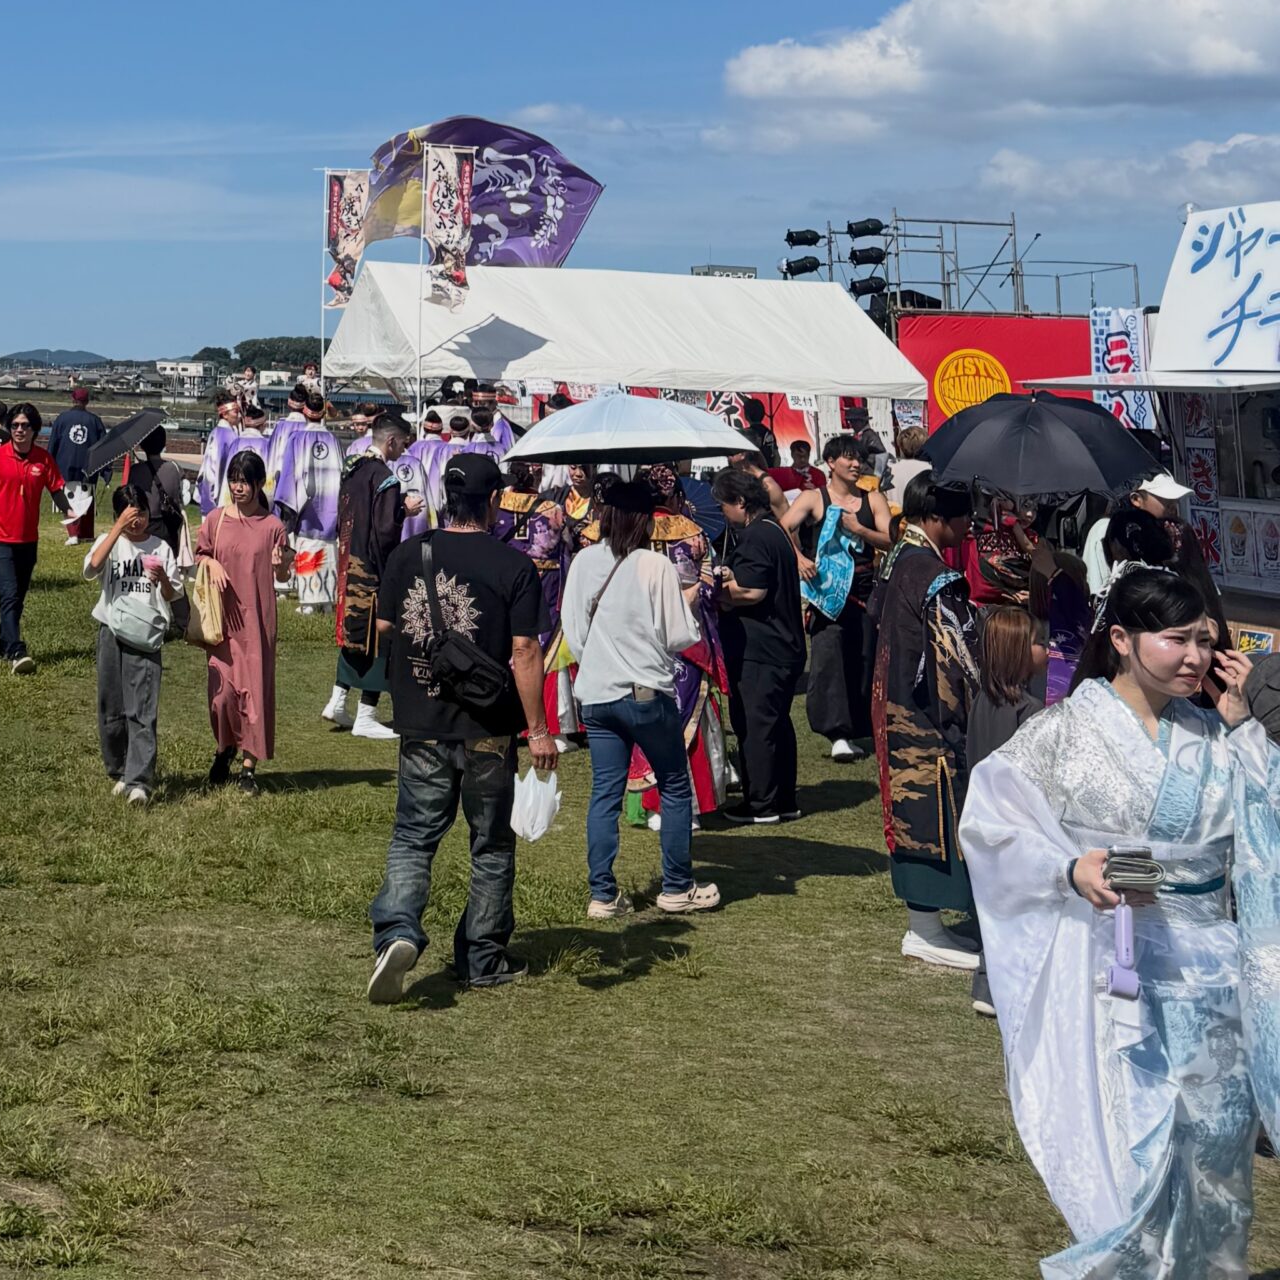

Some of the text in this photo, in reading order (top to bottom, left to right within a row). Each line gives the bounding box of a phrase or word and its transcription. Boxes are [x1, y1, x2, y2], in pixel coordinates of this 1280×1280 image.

[790, 395, 813, 406] 受付
[121, 581, 152, 593] PARIS
[1239, 633, 1270, 653] 生ビール
